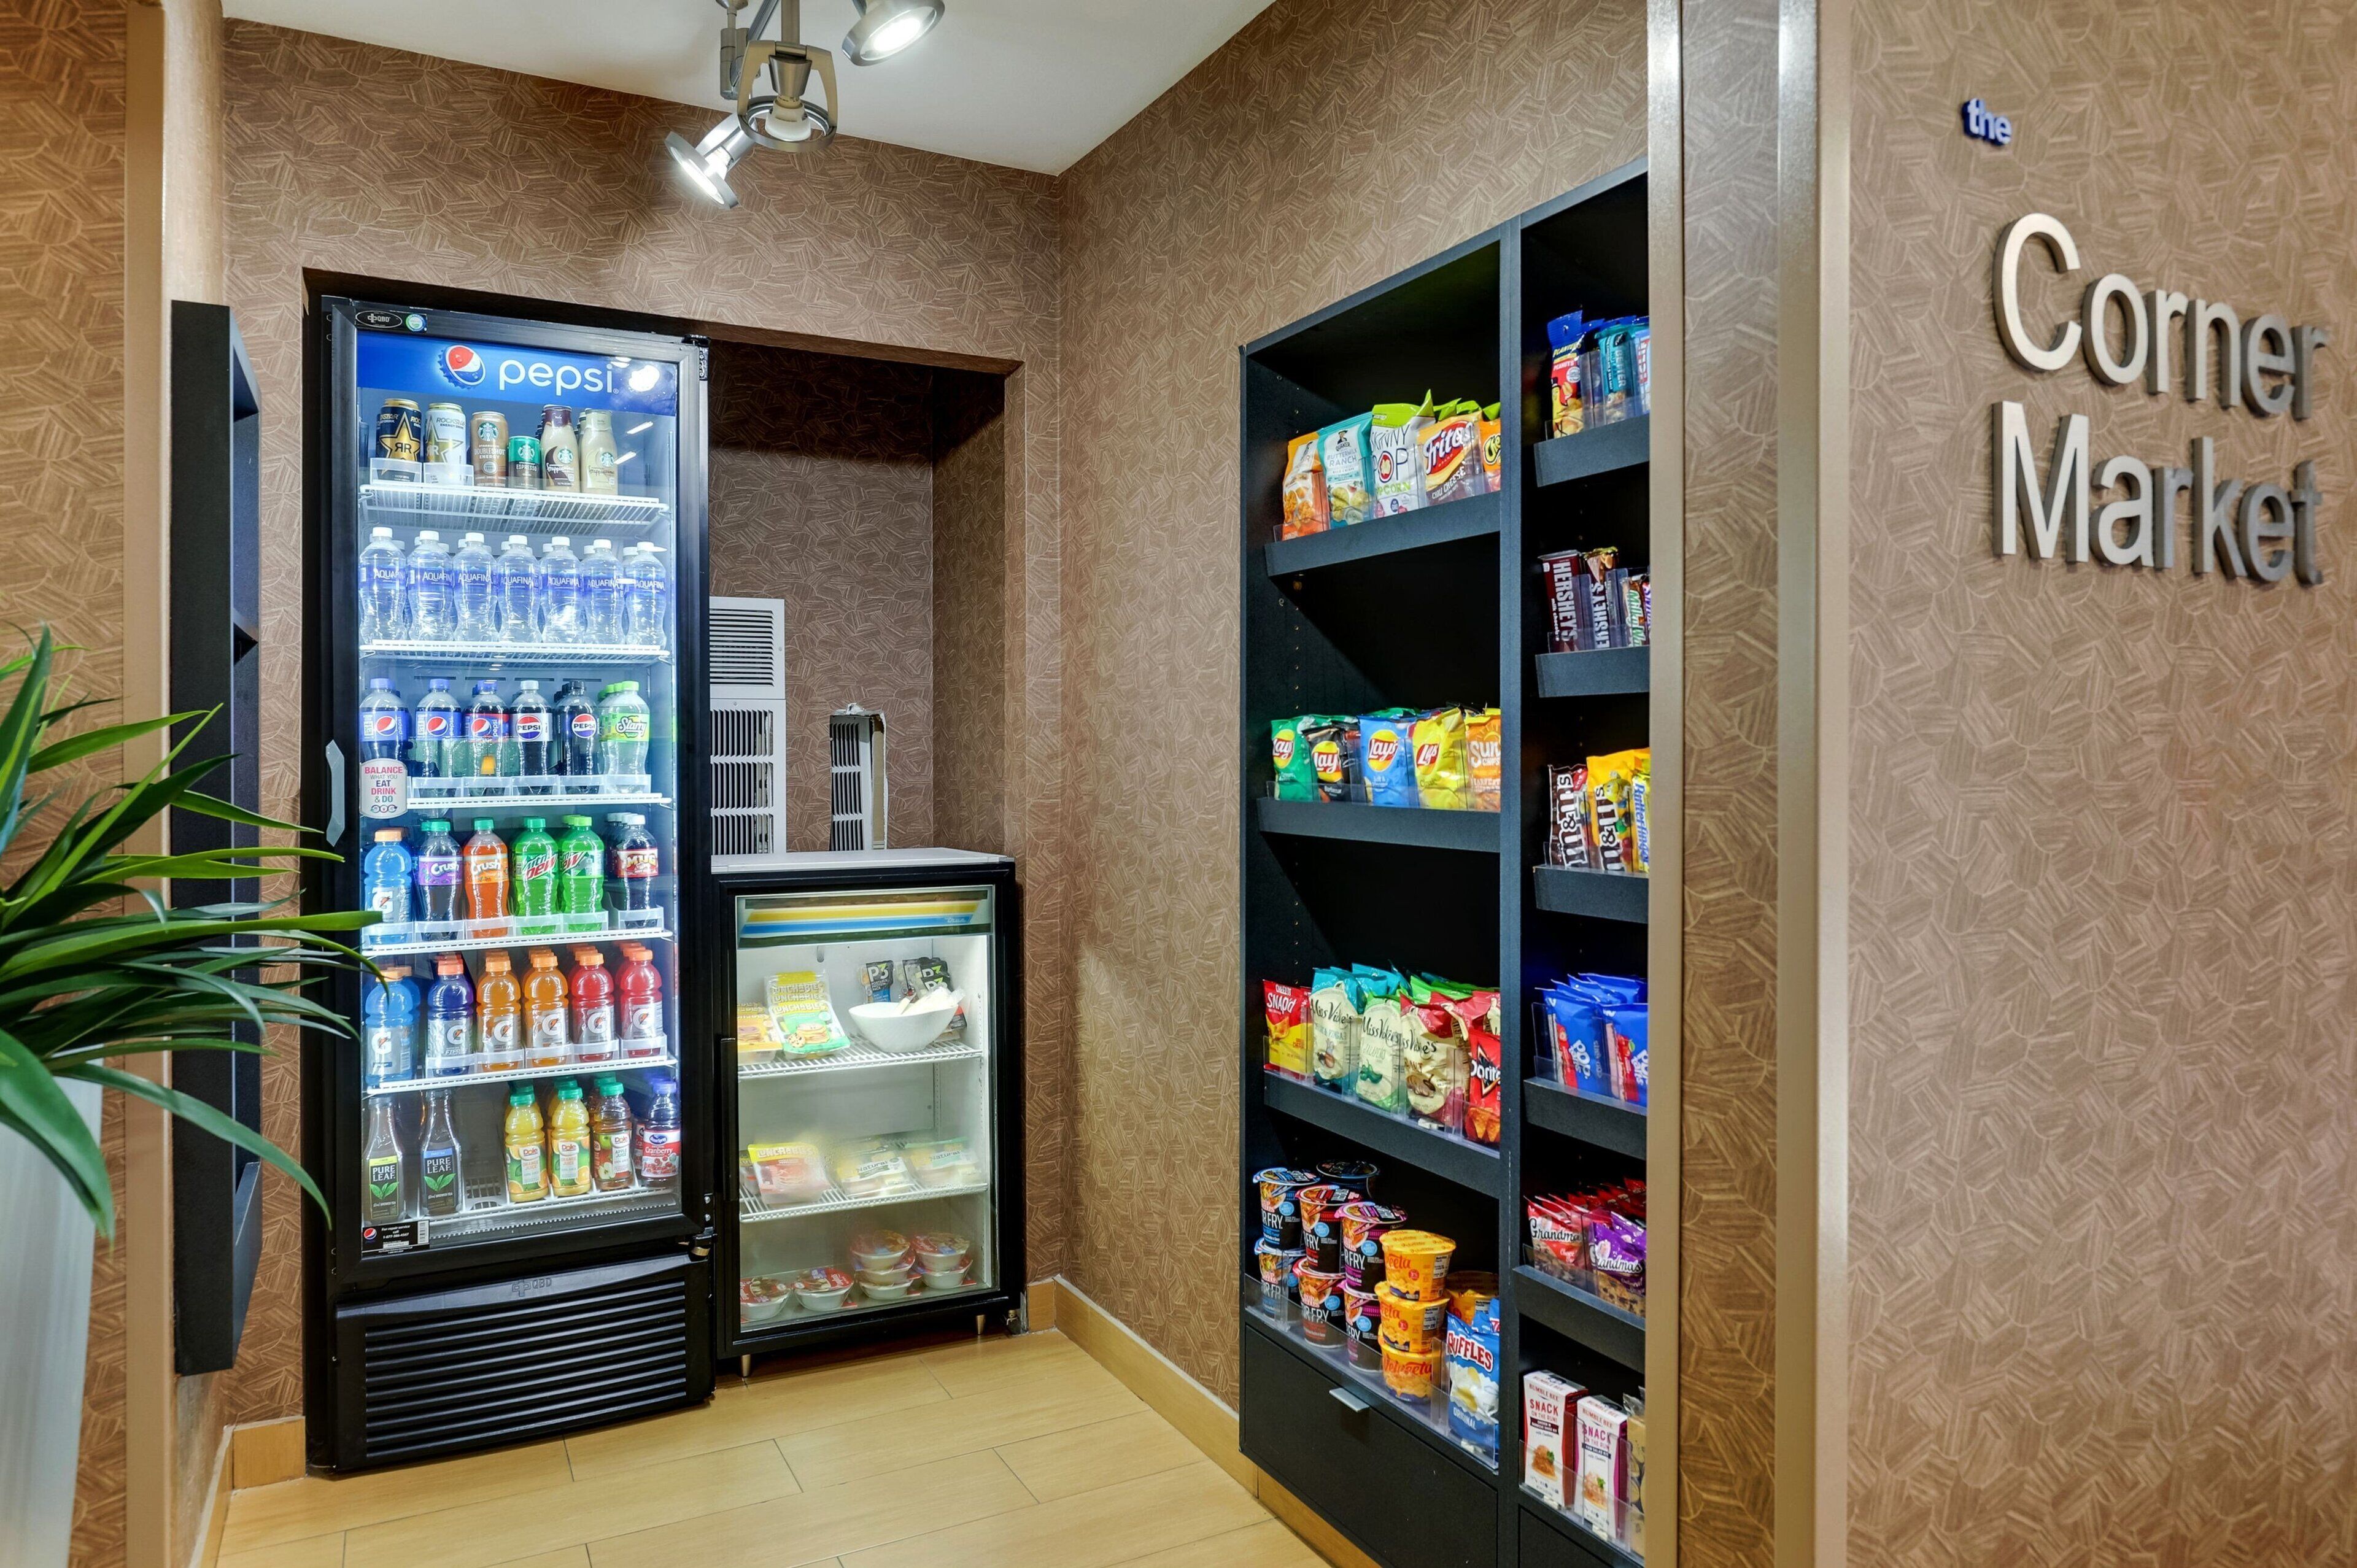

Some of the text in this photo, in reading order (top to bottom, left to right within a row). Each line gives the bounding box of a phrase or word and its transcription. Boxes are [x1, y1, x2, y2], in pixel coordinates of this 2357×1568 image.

[1962, 98, 2011, 145] the
[1993, 212, 2329, 420] Corner
[1553, 360, 1575, 371] PEANUTS
[1616, 350, 1626, 388] BETTER
[499, 360, 613, 396] pepsi
[1327, 448, 1358, 460] BUTTERMILK
[1335, 442, 1351, 452] QUAKER
[1424, 422, 1474, 475] Fritos
[1329, 455, 1357, 467] RANCH
[1372, 447, 1409, 484] POP
[1443, 466, 1466, 493] CHEESE
[1993, 400, 2323, 585] Market
[458, 573, 492, 583] AQUAFINA
[501, 576, 532, 587] AQUAFINA
[548, 577, 579, 587] AQUAFINA
[587, 579, 619, 589] AQUAFINA
[635, 579, 665, 590] AQUAFINA
[1553, 561, 1578, 642] HERSHEY'S
[1369, 739, 1398, 761] Lay's
[1470, 741, 1501, 768] Sun
[1633, 782, 1650, 865] Butterfinger
[471, 859, 501, 875] Crush
[627, 854, 656, 867] MUG
[431, 863, 459, 877] Crush
[868, 963, 889, 982] P3
[773, 1002, 826, 1014] LUNCHABLES
[373, 1165, 396, 1175] PURE
[427, 1157, 451, 1166] PURE
[856, 1160, 889, 1173] Natural
[532, 1277, 552, 1288] QBD
[1447, 1332, 1493, 1372] RUFFLES
[1529, 1383, 1549, 1396] BUMBLE
[1549, 1392, 1559, 1402] BEE
[1530, 1399, 1558, 1416] SNACK
[1453, 1407, 1476, 1431] ORIGINAL
[1582, 1408, 1602, 1423] BUMBLE
[1603, 1418, 1612, 1428] BEE
[1582, 1423, 1611, 1444] SNACK
